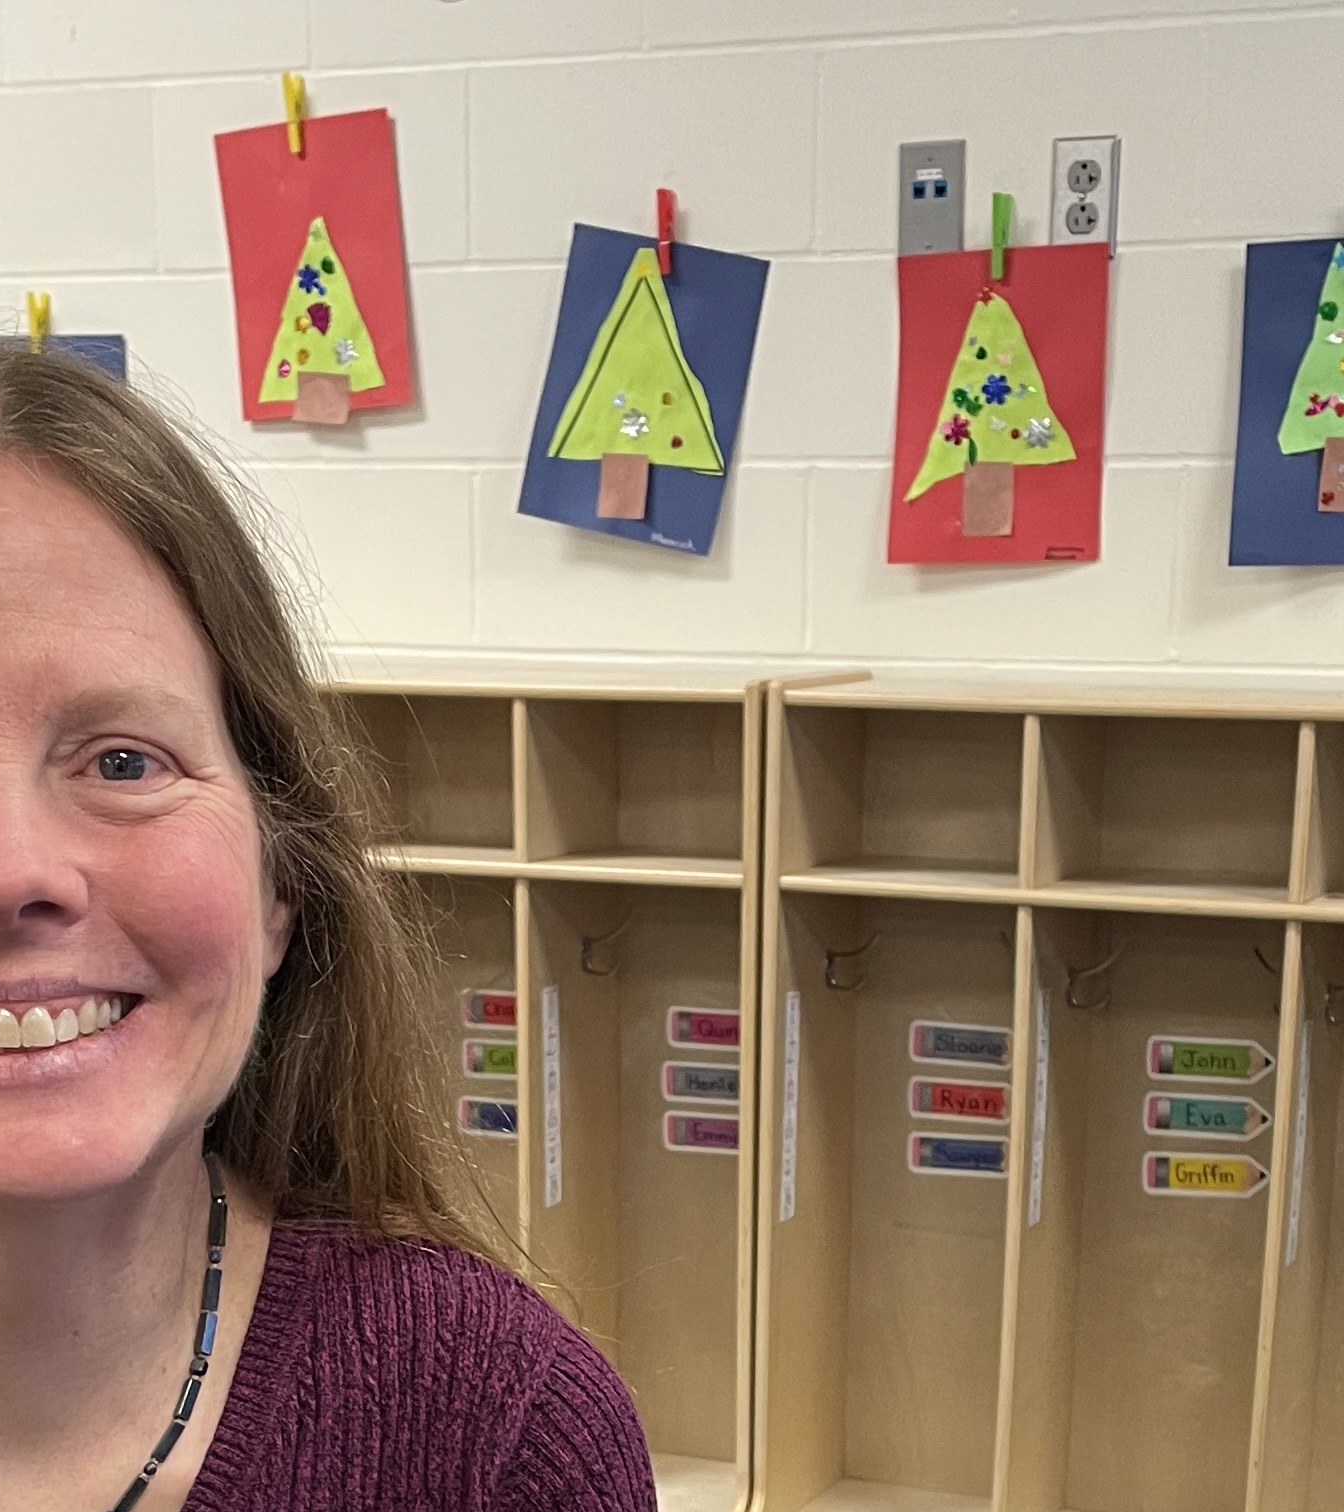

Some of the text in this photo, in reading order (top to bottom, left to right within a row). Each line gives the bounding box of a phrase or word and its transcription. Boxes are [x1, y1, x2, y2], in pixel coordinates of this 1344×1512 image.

[1181, 1050, 1236, 1072] John
[940, 1088, 1000, 1114] Ryan
[1186, 1103, 1227, 1127] Eva
[1175, 1162, 1235, 1186] Griffin
